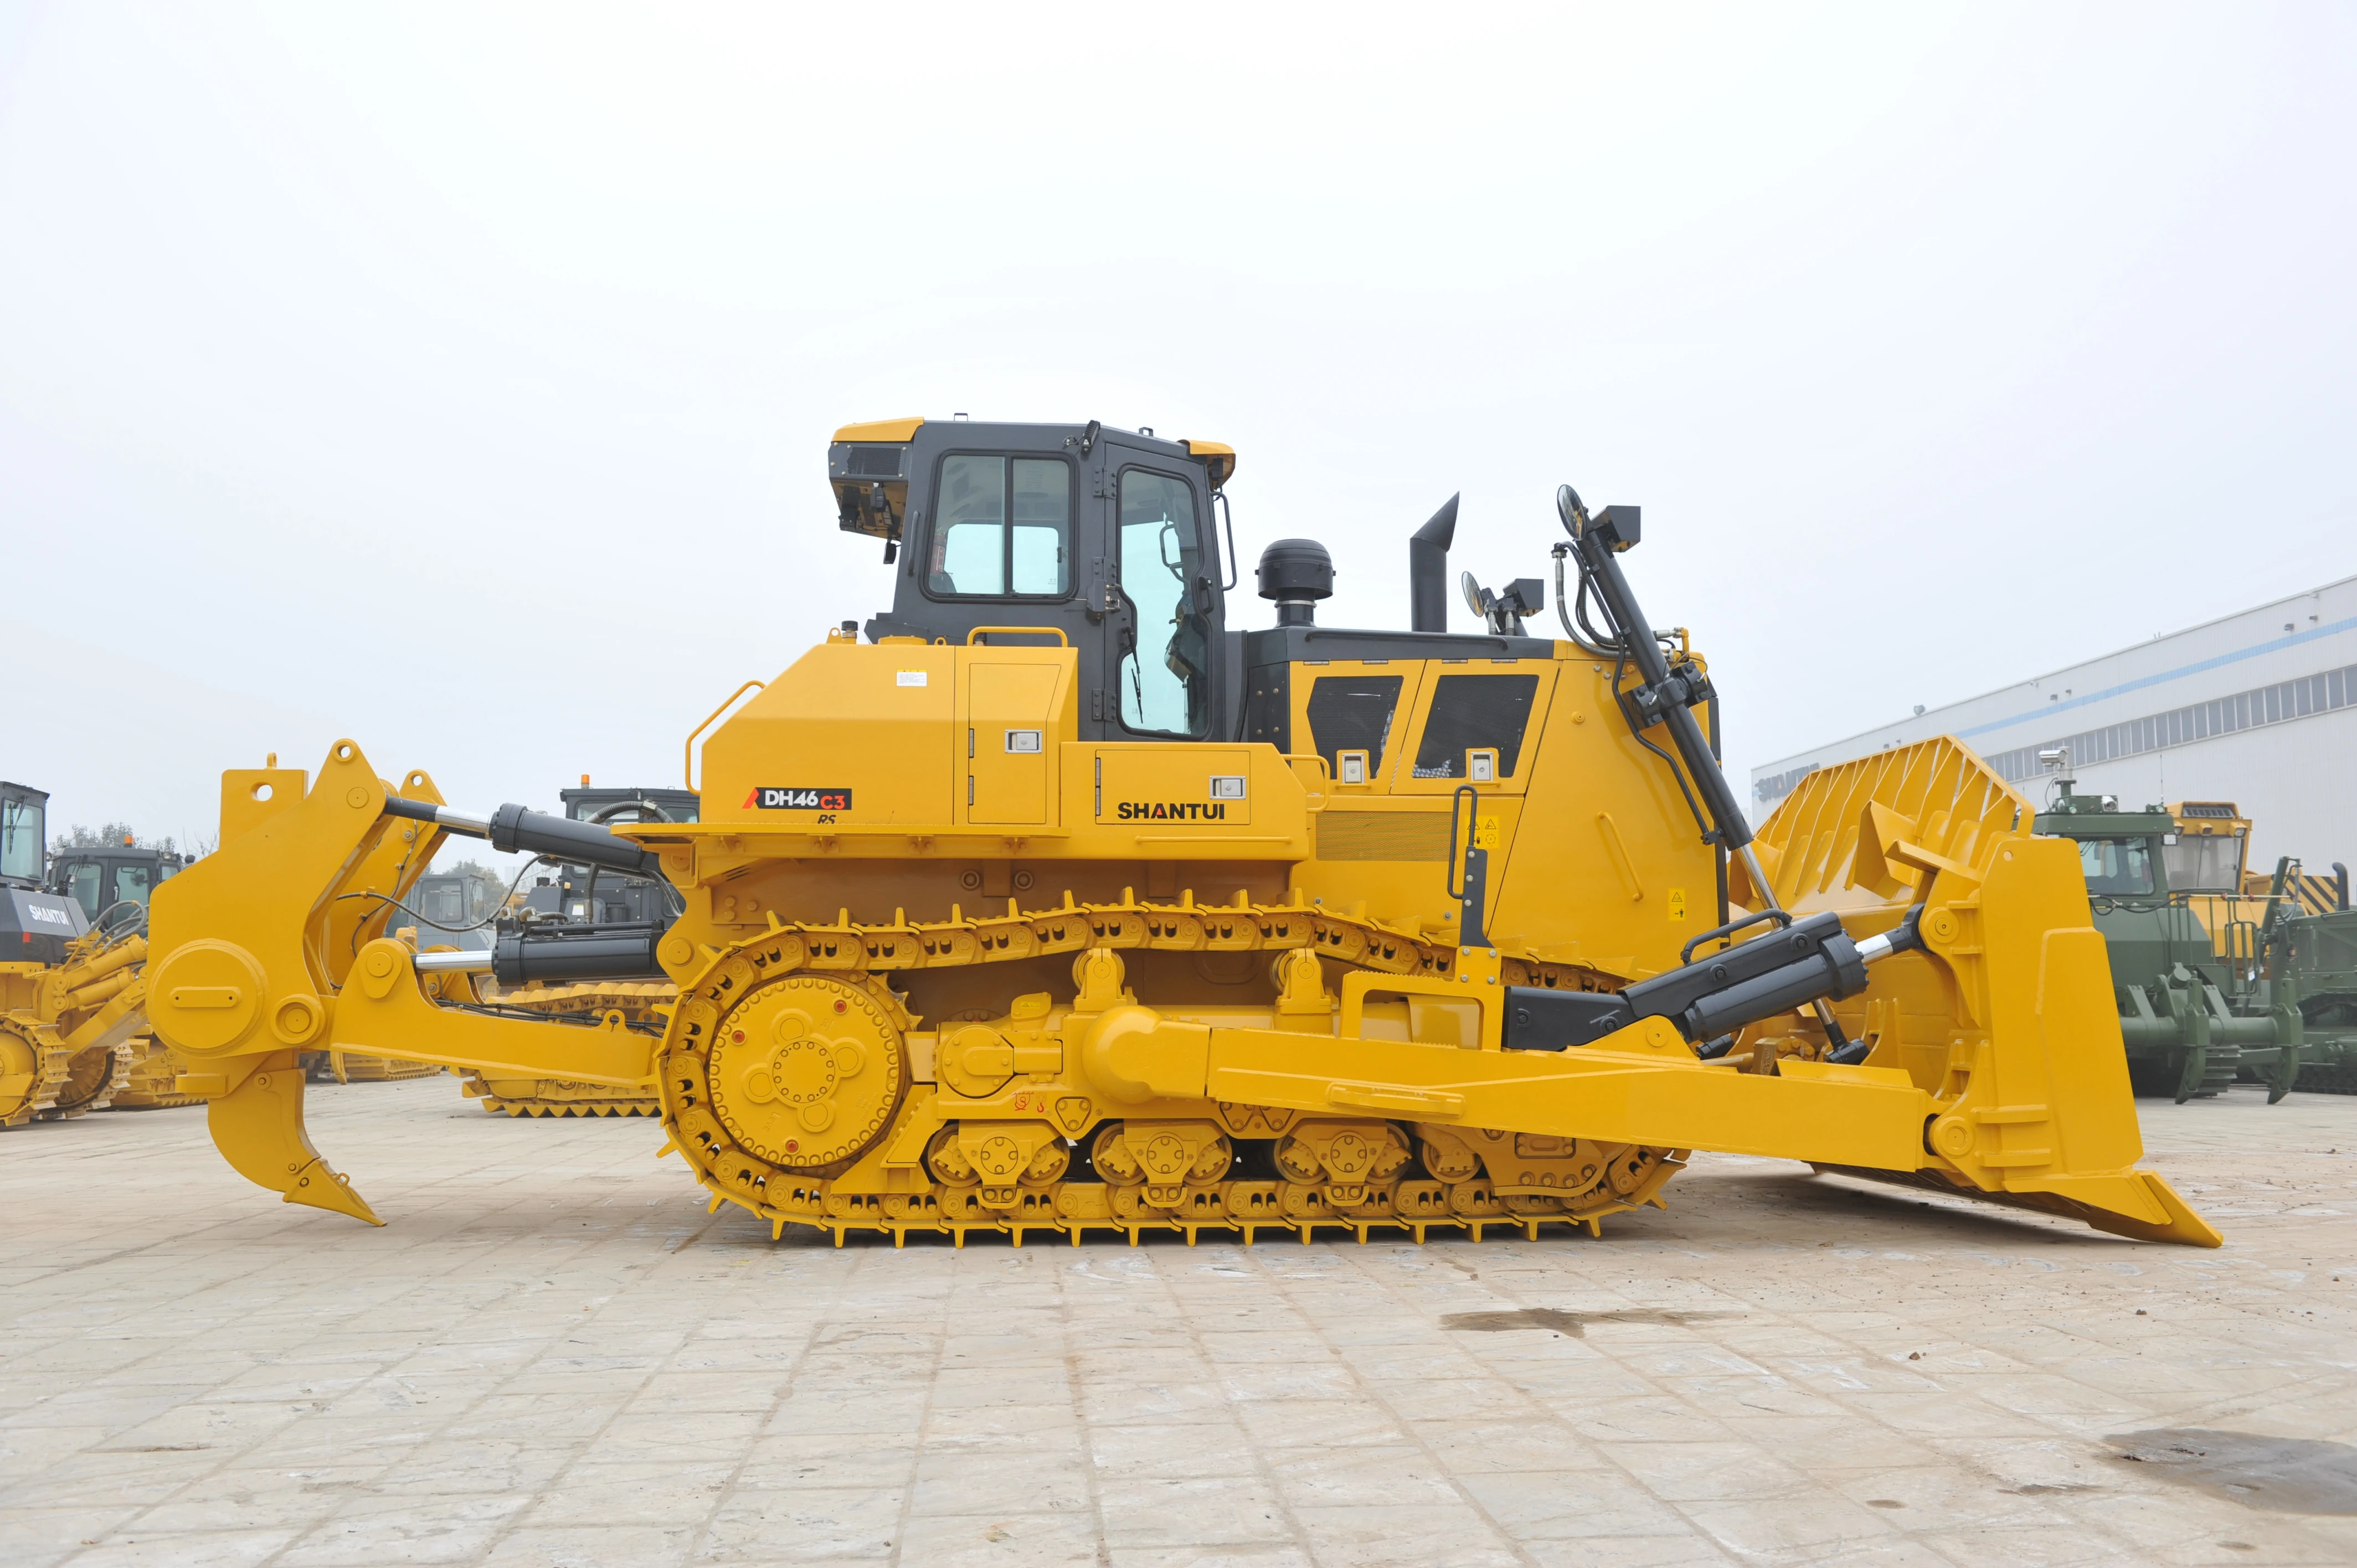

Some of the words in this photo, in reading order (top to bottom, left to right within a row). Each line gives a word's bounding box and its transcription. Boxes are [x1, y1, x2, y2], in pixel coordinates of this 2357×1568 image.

[817, 814, 837, 824] RS
[1118, 802, 1224, 819] SHANTUI
[28, 904, 69, 926] SHANTUI
